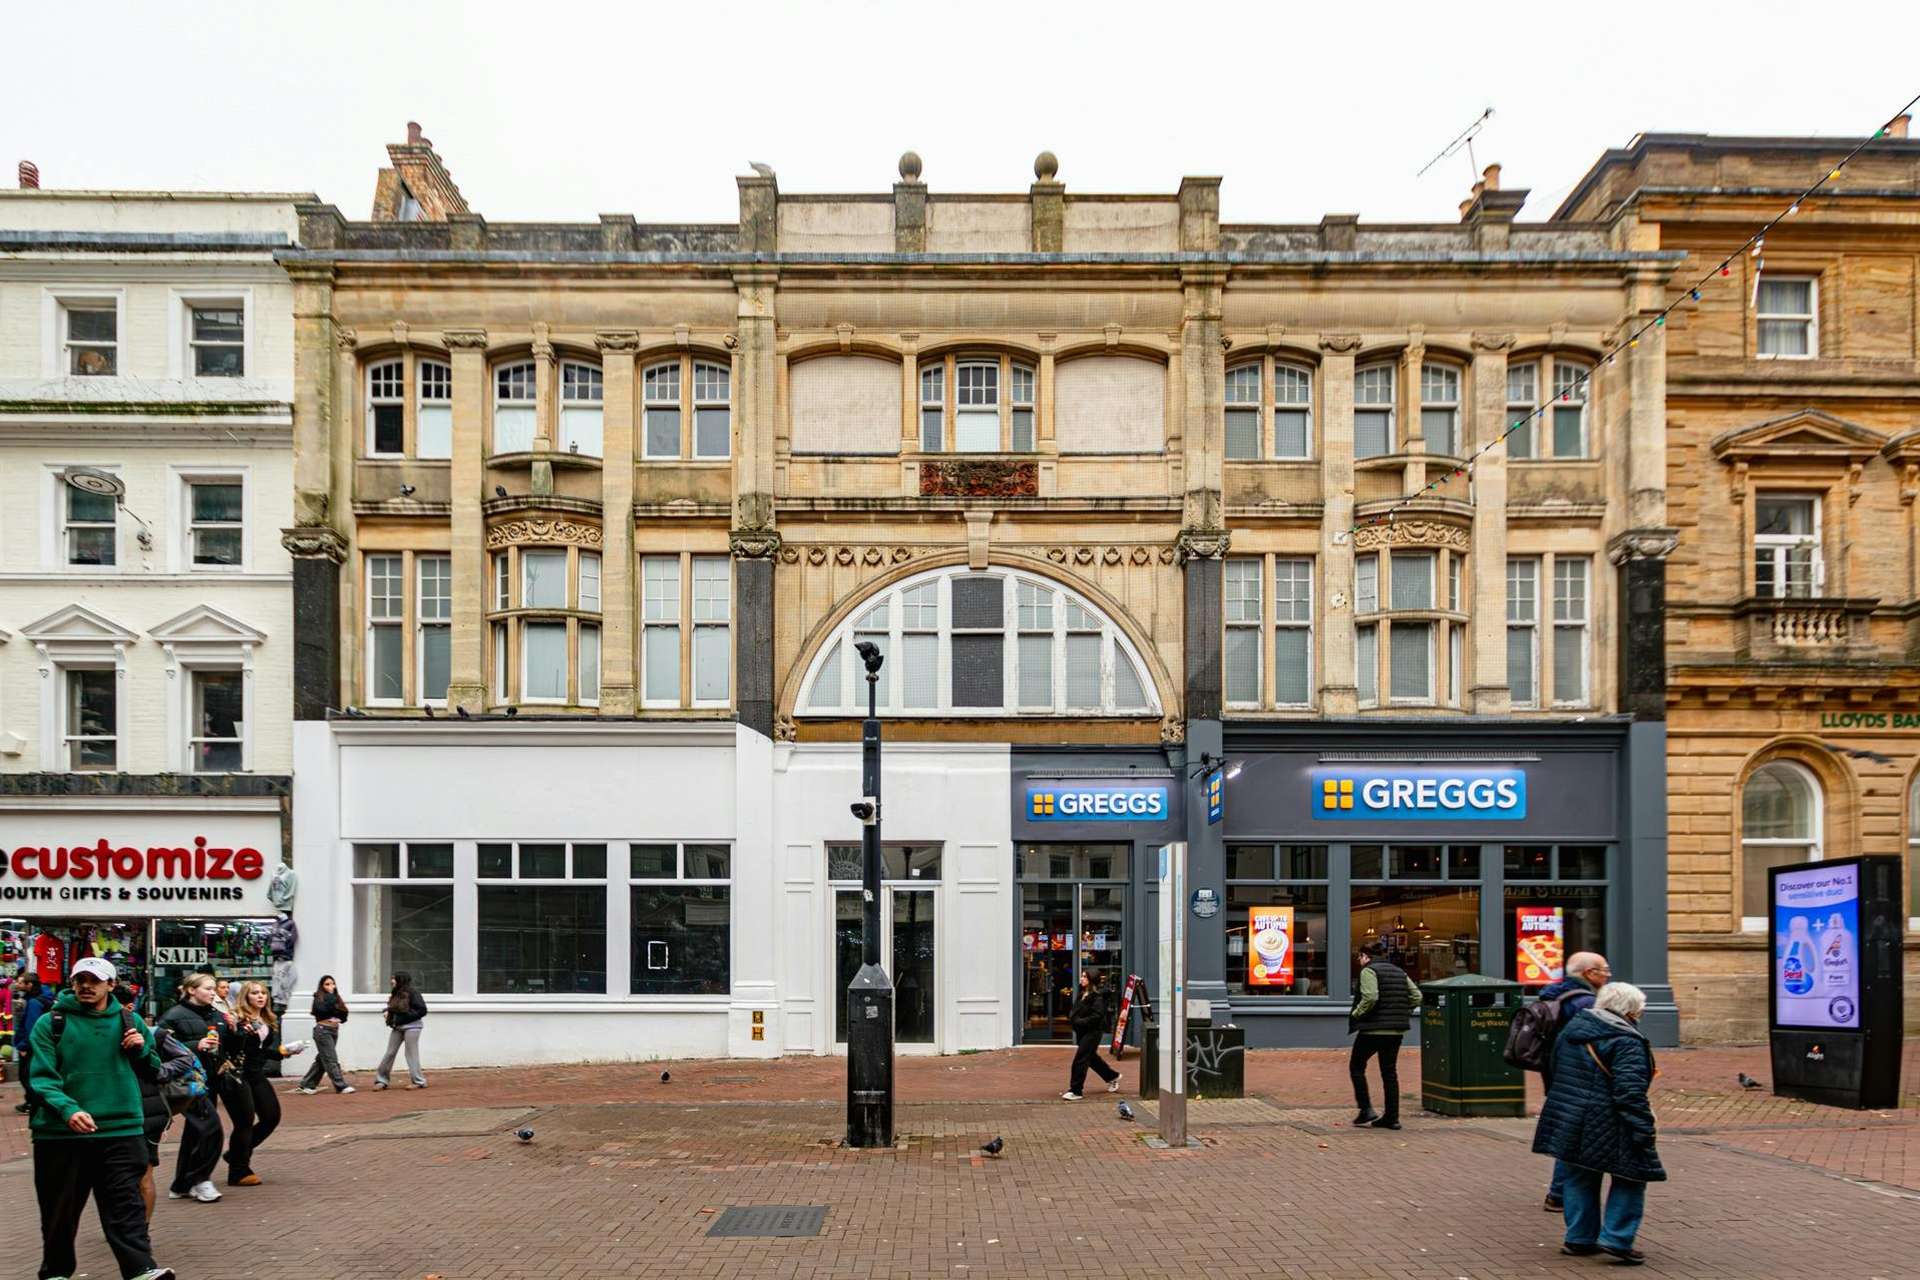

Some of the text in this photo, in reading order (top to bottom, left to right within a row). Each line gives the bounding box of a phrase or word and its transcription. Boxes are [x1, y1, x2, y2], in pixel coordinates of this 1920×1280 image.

[1822, 713, 1887, 728] LLOYDS
[1362, 779, 1518, 808] GREGGS
[1059, 793, 1161, 814] GREGGS
[0, 886, 244, 900] OUTH GIFTS & SOUVENIRS
[1780, 881, 1815, 892] Discover
[1816, 880, 1831, 888] our
[159, 949, 206, 963] SALE
